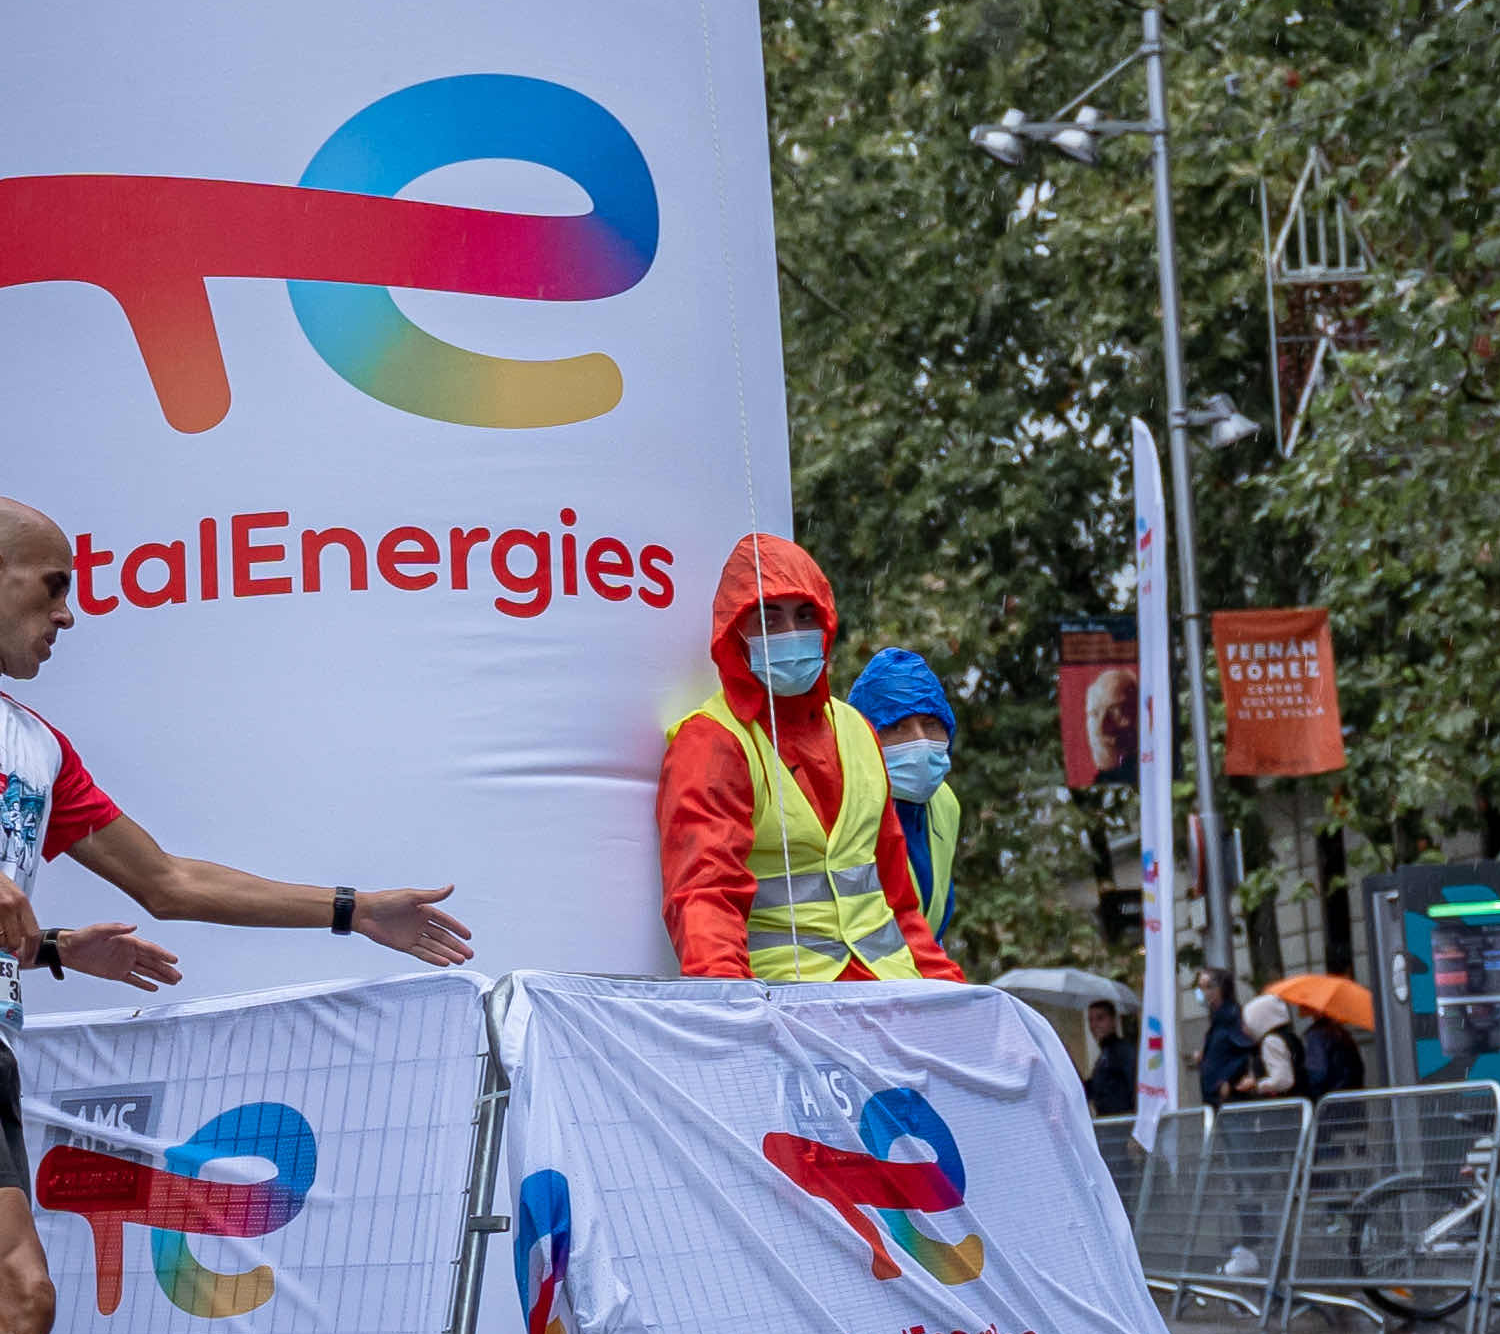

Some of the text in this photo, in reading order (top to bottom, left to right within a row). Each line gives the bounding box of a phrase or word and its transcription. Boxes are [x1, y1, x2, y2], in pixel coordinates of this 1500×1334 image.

[73, 507, 675, 618] talEnergies
[1226, 637, 1318, 661] FERNÁN
[1229, 658, 1320, 681] GÓMEZ
[799, 1070, 854, 1118] AS
